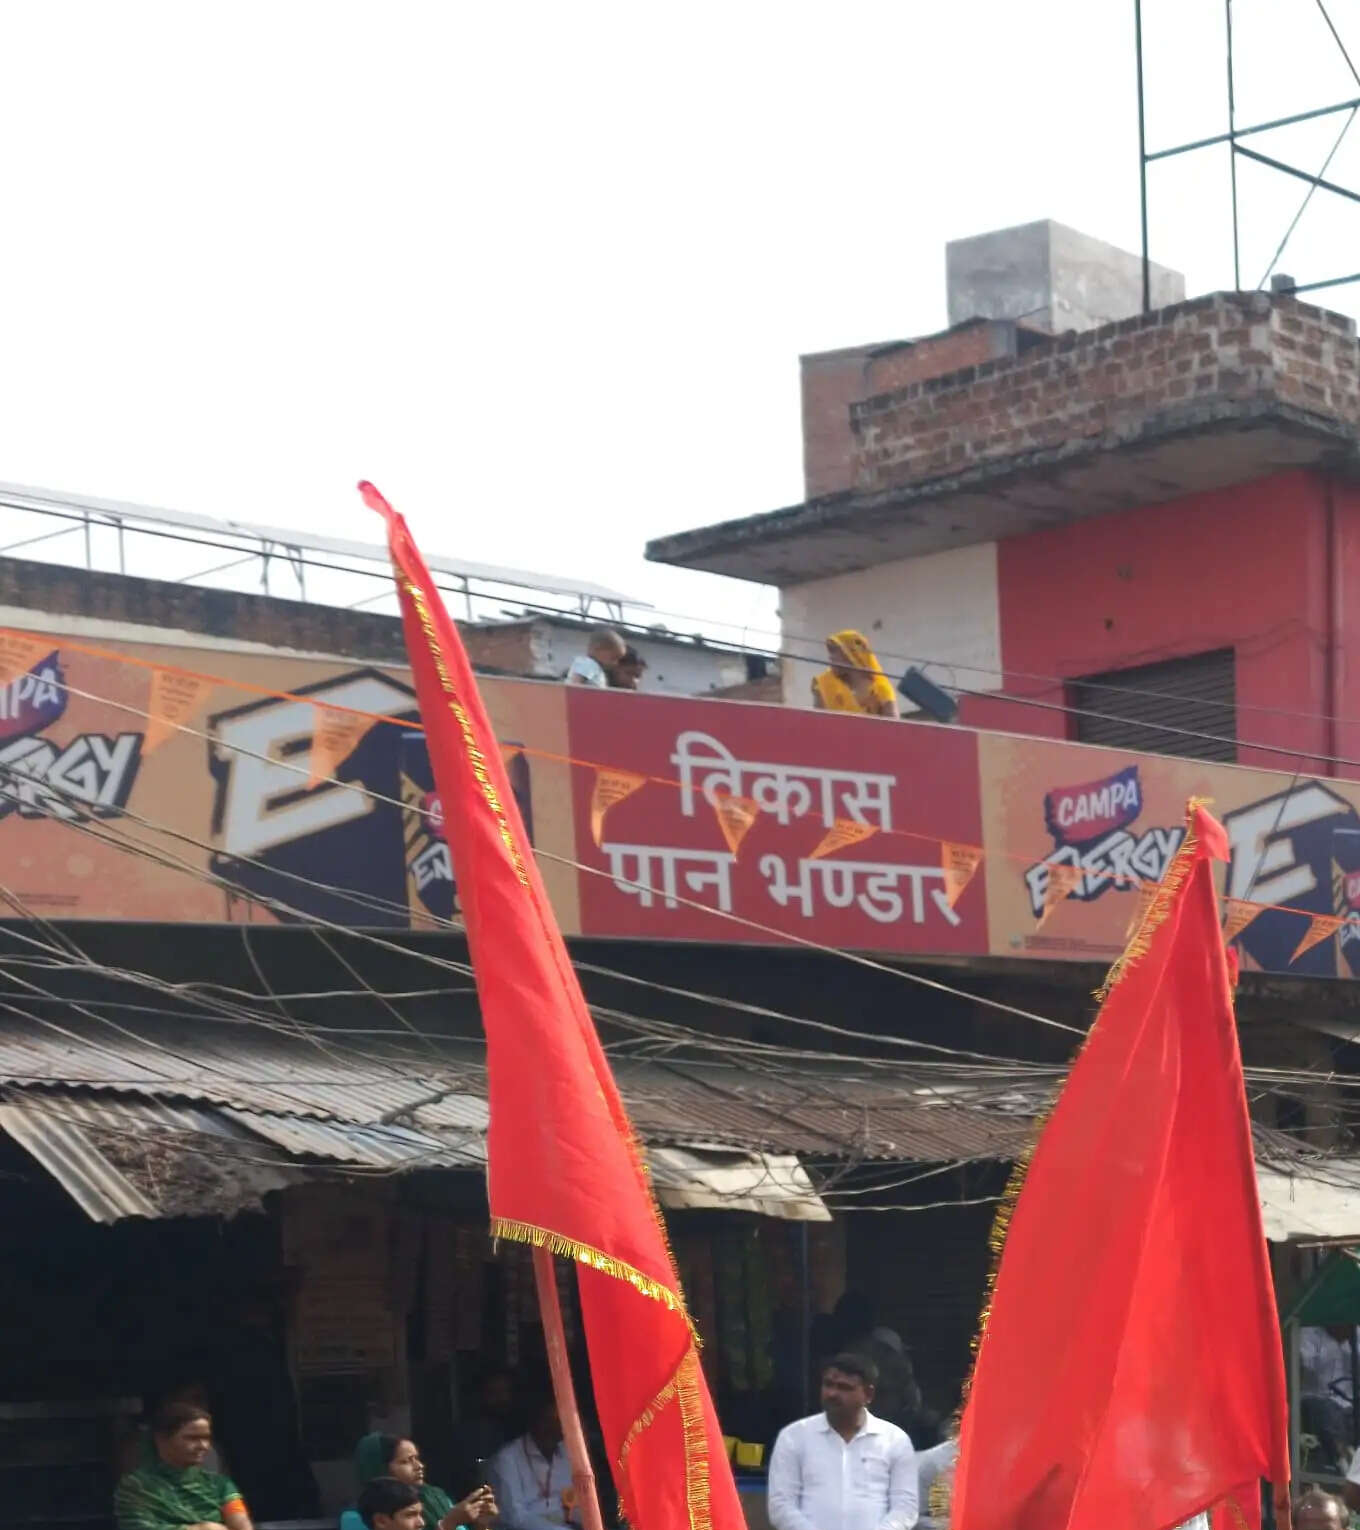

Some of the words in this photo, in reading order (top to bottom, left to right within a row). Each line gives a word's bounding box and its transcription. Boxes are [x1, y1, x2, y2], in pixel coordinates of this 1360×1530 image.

[1058, 779, 1139, 827] CAMPA
[602, 842, 735, 912] पान
[760, 854, 962, 926] भण्डार
[1025, 829, 1187, 914] ENERGY
